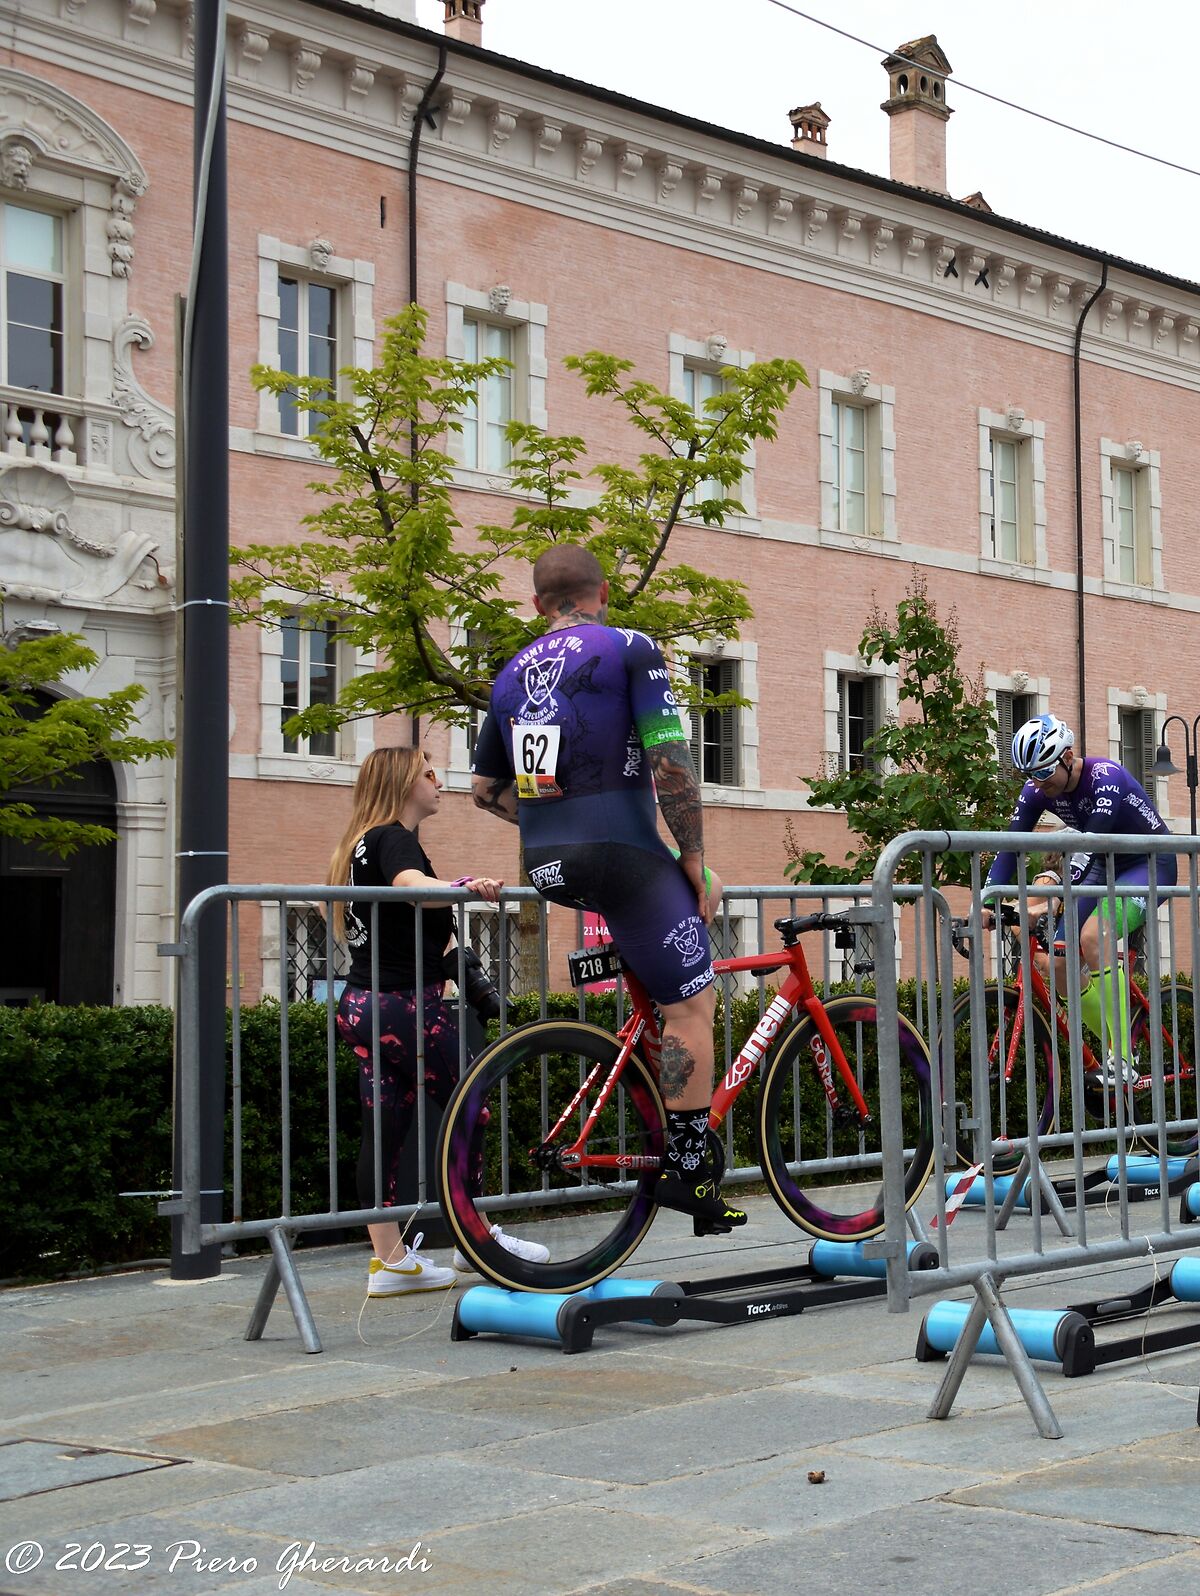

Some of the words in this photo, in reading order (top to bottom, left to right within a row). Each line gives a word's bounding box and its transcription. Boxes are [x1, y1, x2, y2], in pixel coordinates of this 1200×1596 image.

[518, 643, 544, 667] ARMY
[548, 637, 562, 650] OF
[563, 636, 583, 650] TWO
[522, 733, 549, 775] 62
[532, 863, 562, 884] ARMY
[546, 874, 564, 885] TWO
[584, 926, 594, 936] 21
[663, 928, 678, 945] ARMY
[678, 920, 686, 930] OF
[579, 957, 604, 979] 218
[1144, 1187, 1159, 1196] Tacx
[746, 1303, 771, 1316] Tacx
